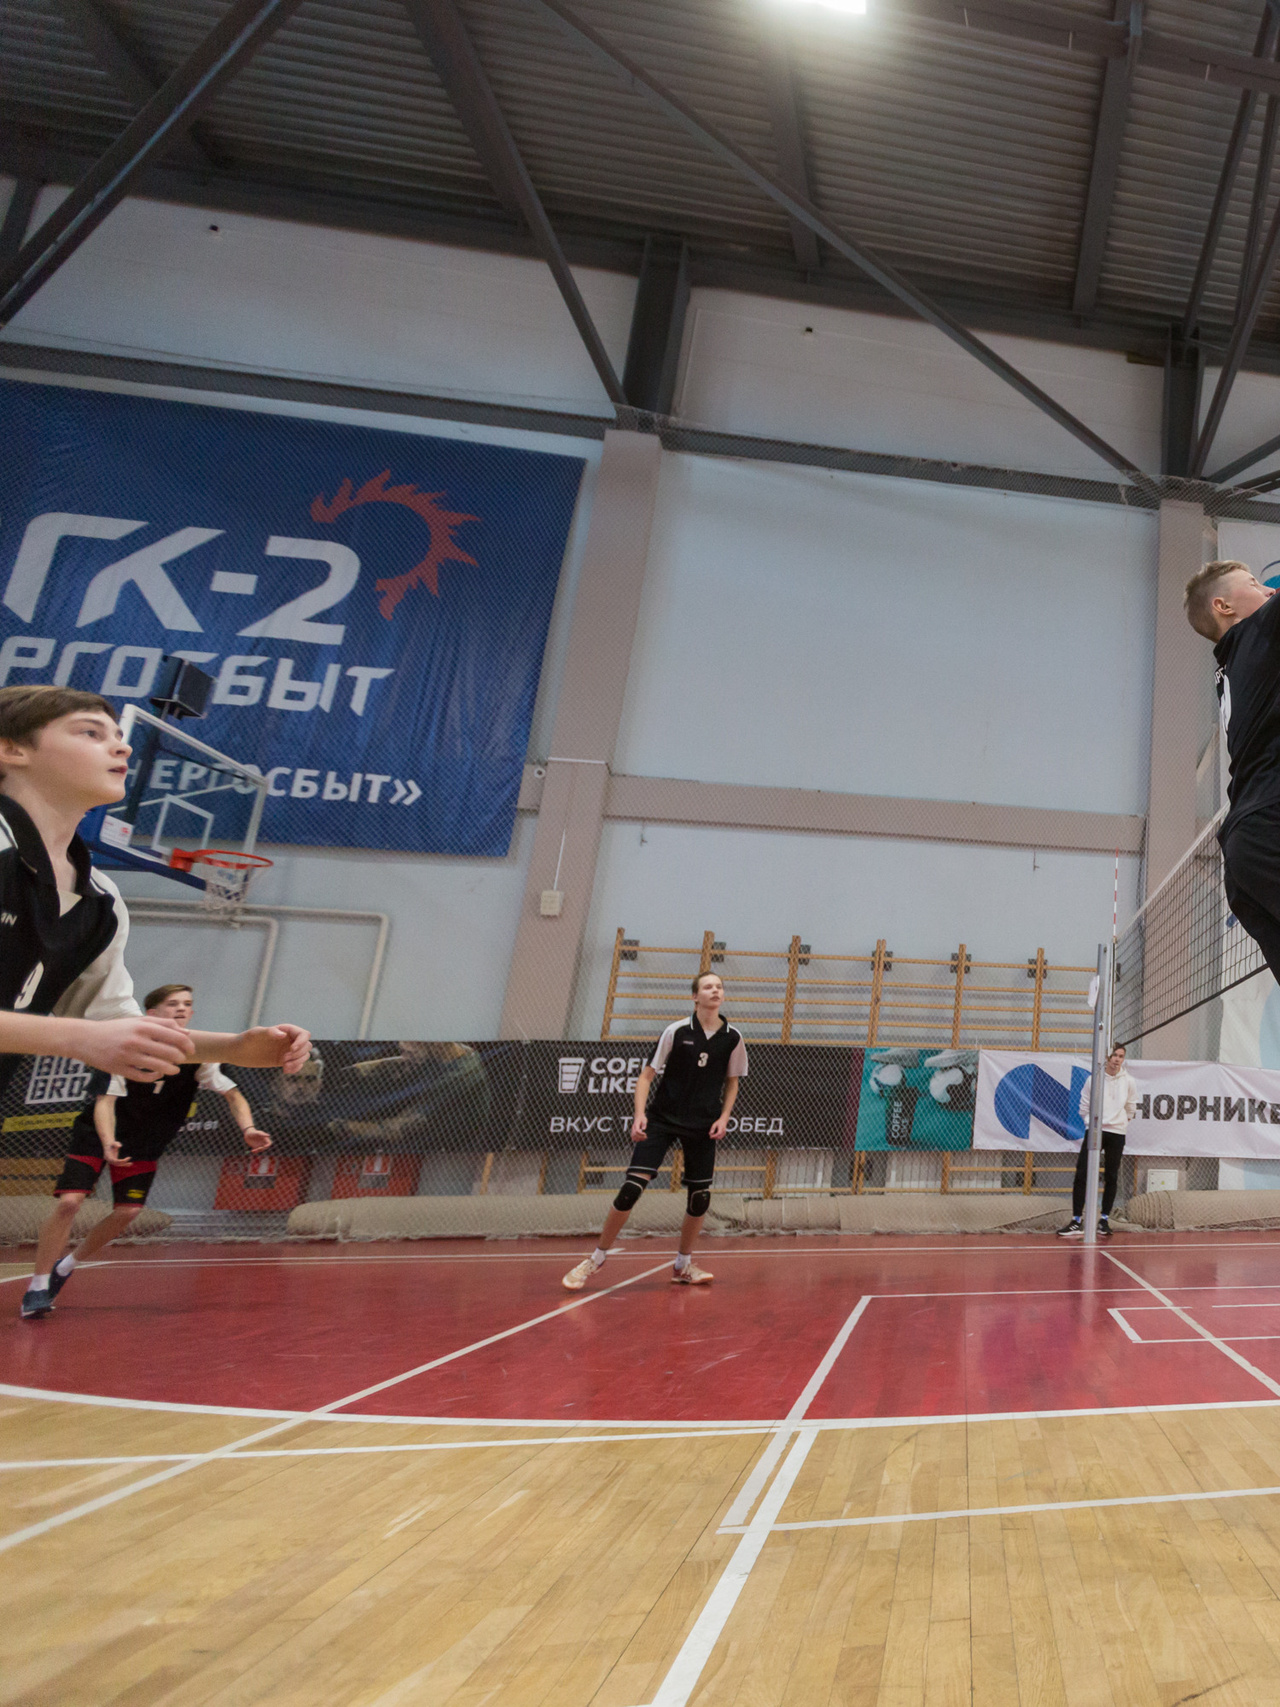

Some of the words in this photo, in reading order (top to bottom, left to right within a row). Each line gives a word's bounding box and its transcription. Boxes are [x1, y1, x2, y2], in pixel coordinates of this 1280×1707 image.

[0, 635, 396, 717] РГОБЫТ
[14, 961, 45, 1010] 9
[36, 1055, 83, 1077] BIG
[697, 1051, 709, 1068] 3
[587, 1076, 638, 1093] LIKE
[549, 1116, 613, 1133] ВКУС
[890, 1100, 903, 1139] COFFEE
